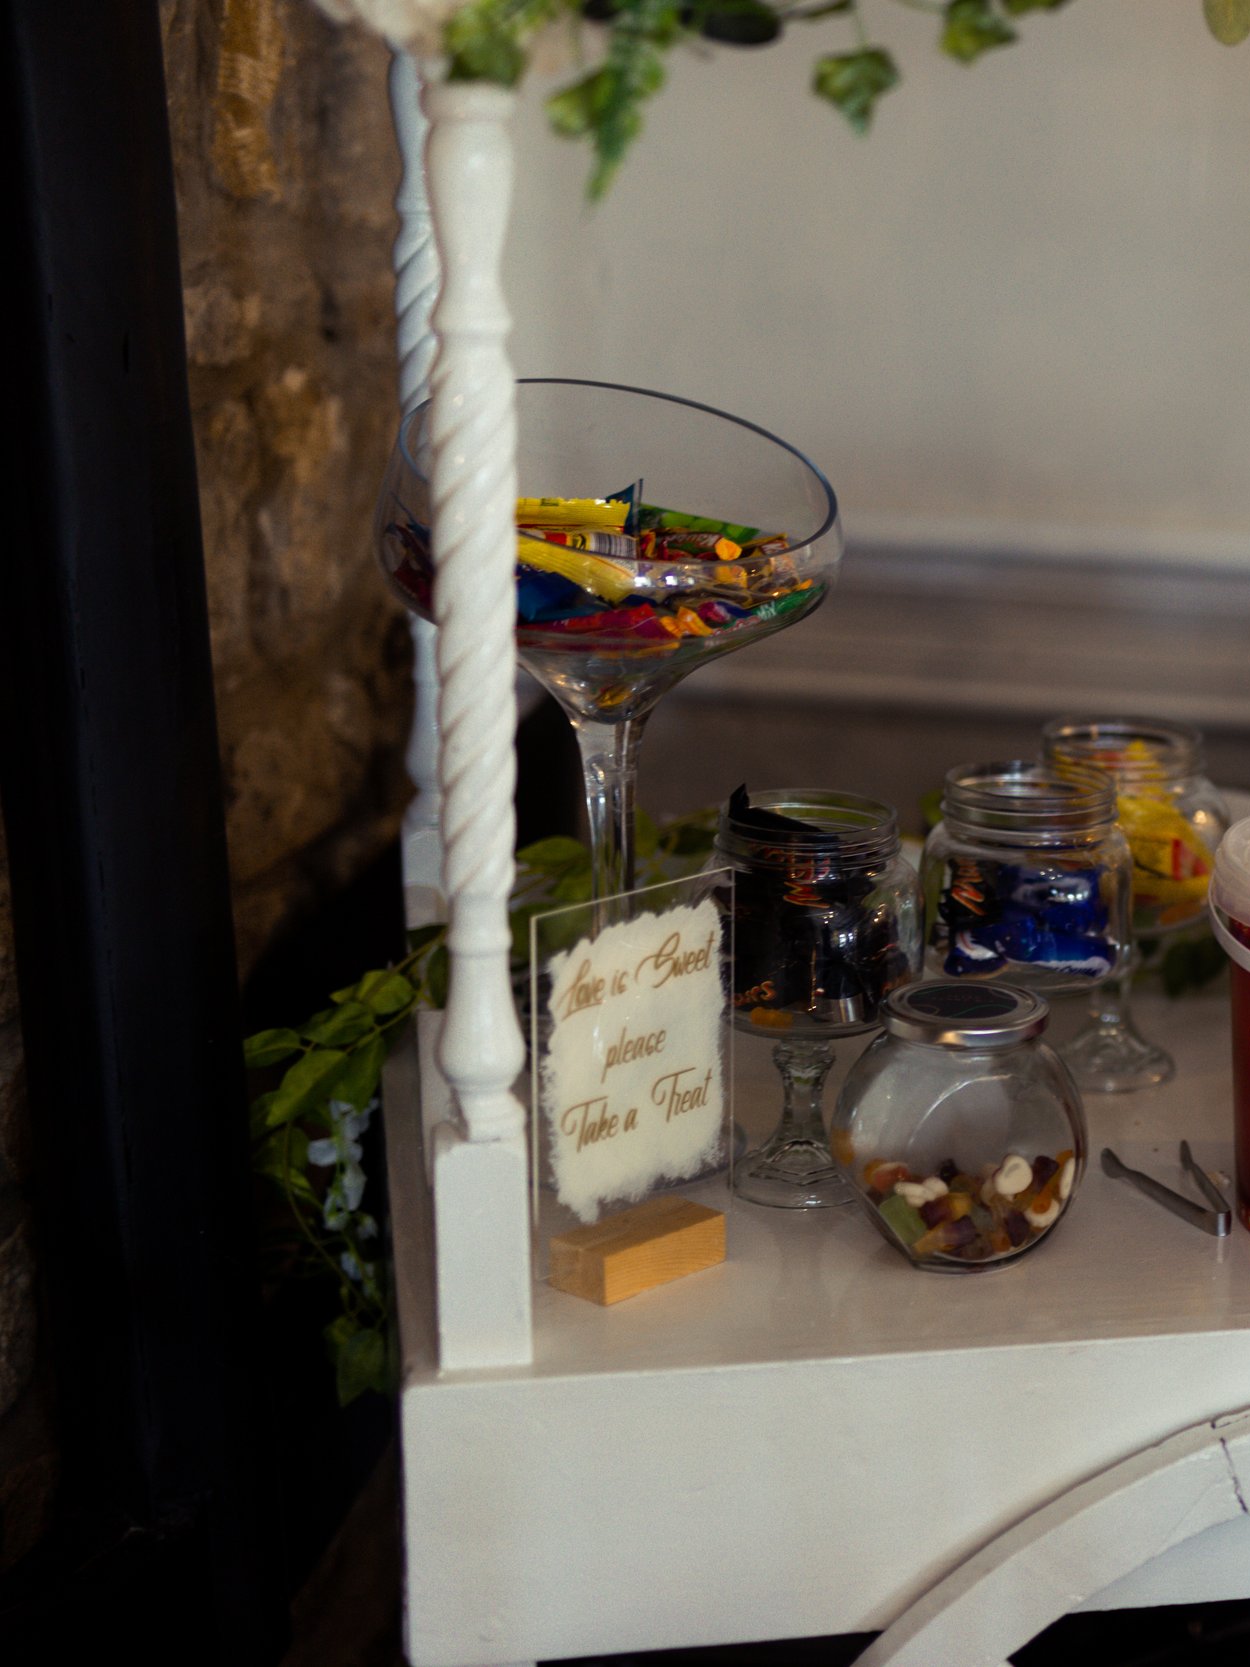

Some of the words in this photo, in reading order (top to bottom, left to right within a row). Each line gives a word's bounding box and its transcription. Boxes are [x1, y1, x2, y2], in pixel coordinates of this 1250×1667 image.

[557, 959, 606, 1021] Love
[610, 969, 629, 997] is
[635, 931, 715, 988] Sweet
[601, 1026, 667, 1084] please
[560, 1095, 620, 1153] Take
[623, 1108, 639, 1132] a
[651, 1066, 713, 1123] Treat
